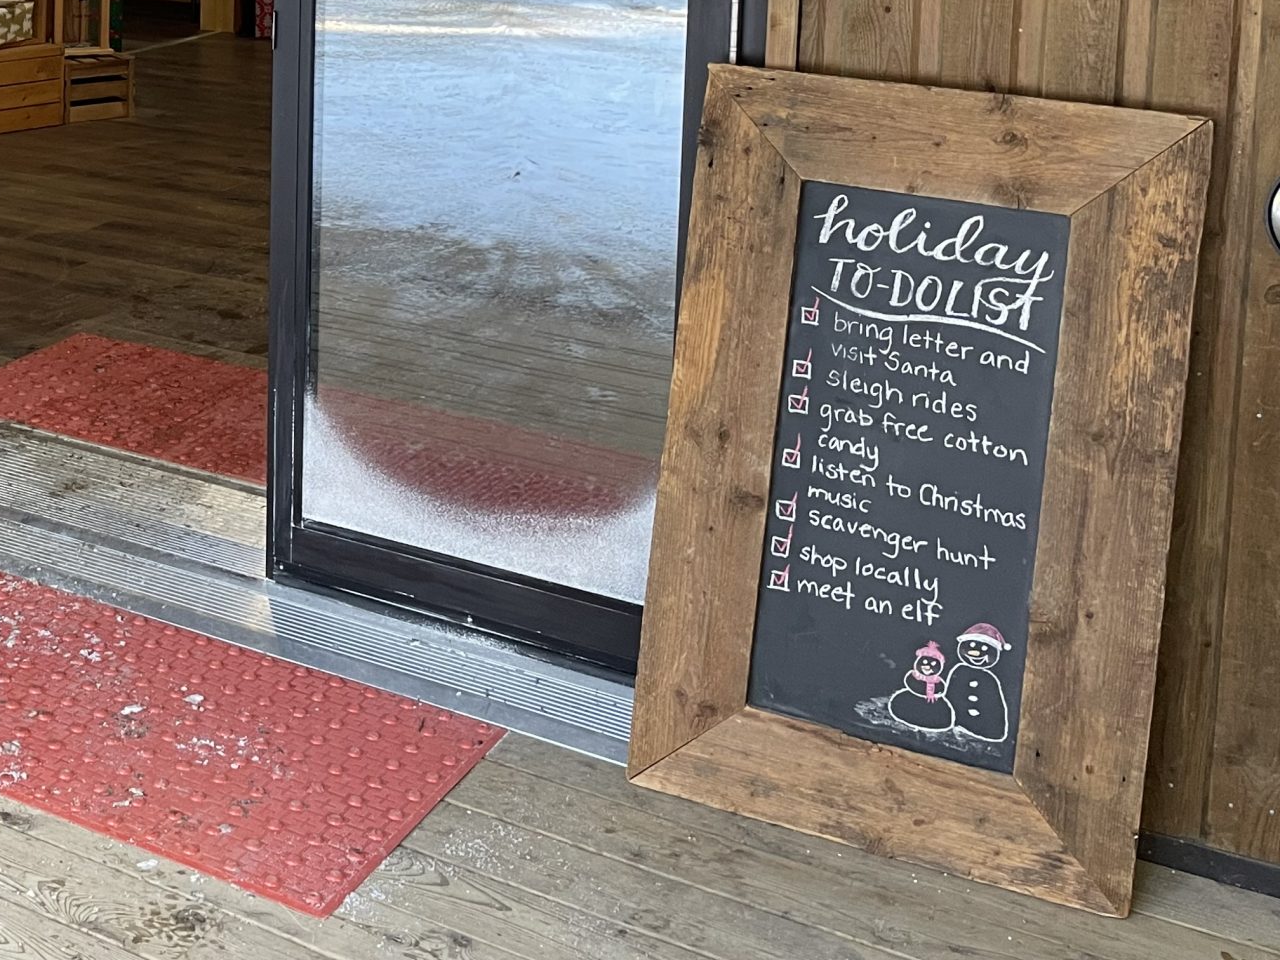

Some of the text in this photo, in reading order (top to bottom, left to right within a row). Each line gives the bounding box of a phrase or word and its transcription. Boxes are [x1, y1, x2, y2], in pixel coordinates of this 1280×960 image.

[814, 194, 1054, 308] holiday
[831, 342, 957, 388] visit Santa
[833, 311, 1030, 375] bring letter and
[820, 403, 1029, 466] grab free cotton
[912, 391, 978, 422] rides
[817, 433, 879, 472] candy
[807, 484, 872, 513] music
[811, 455, 1027, 530] listen to Christmas
[808, 509, 996, 570] scavenger hunt
[797, 578, 944, 626] meet an elf
[799, 544, 939, 604] shop locally
